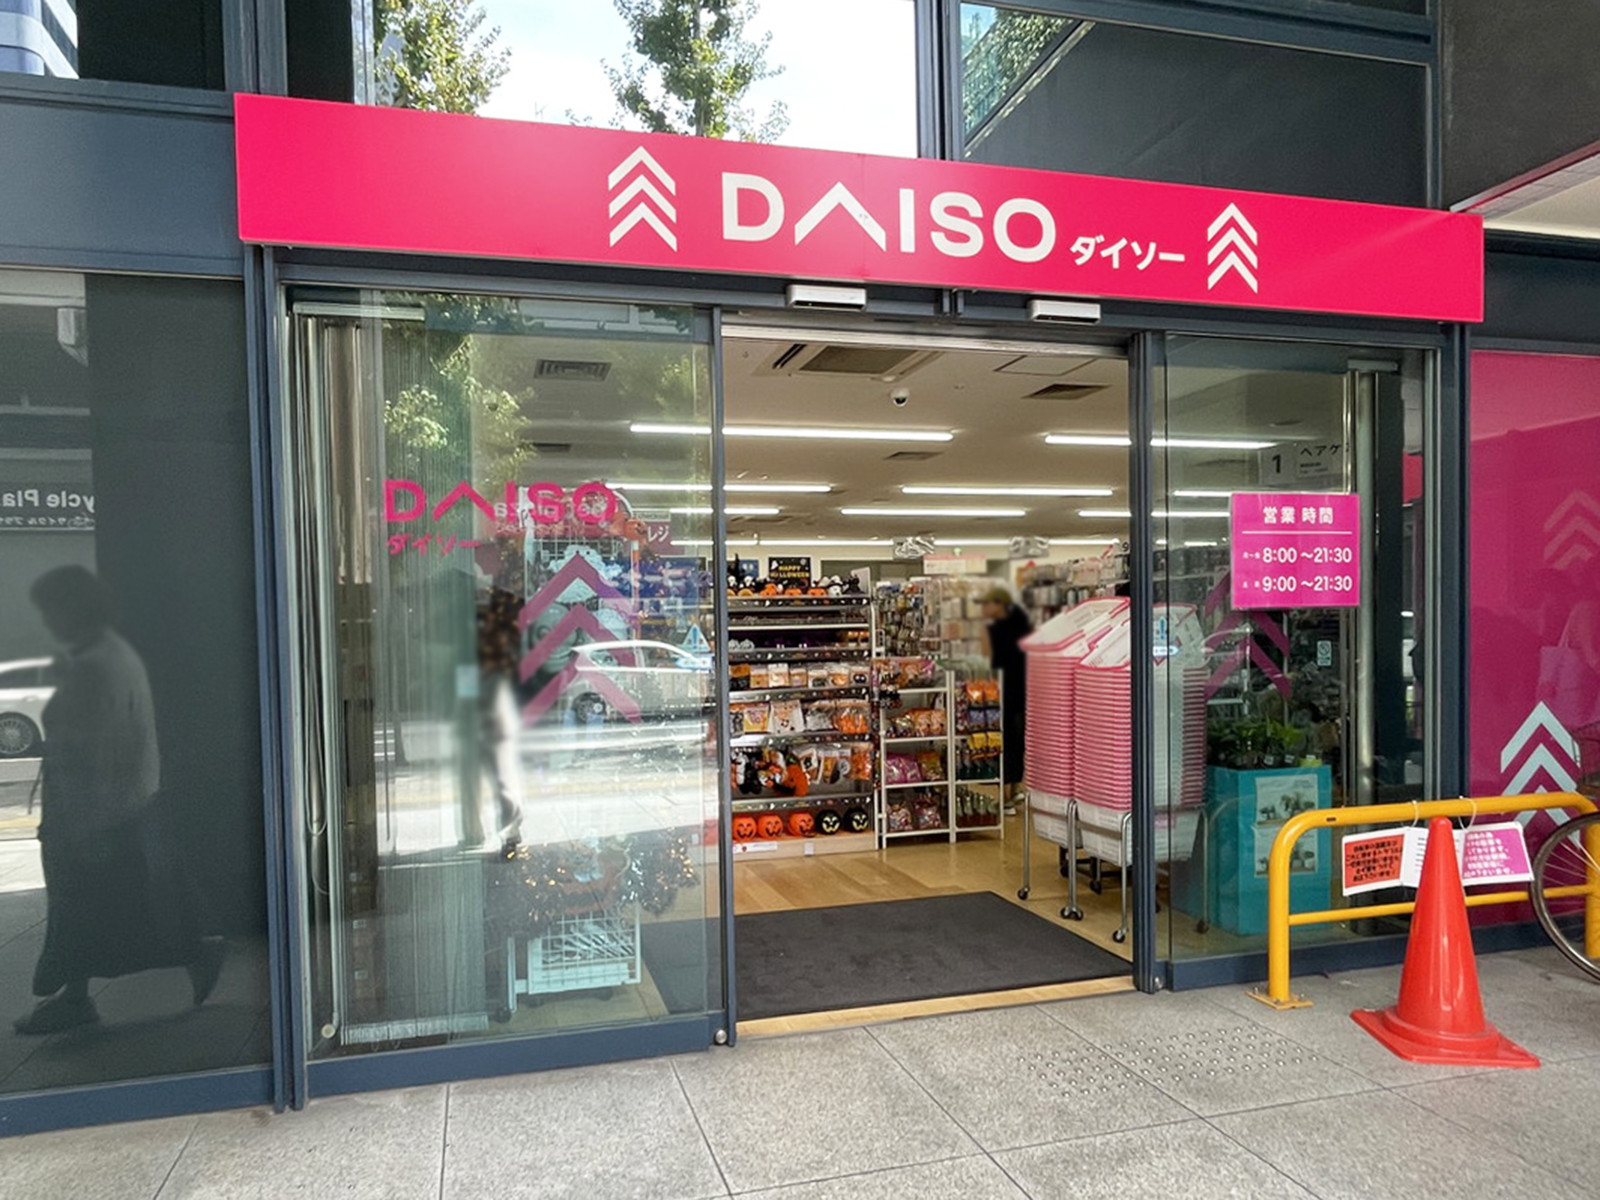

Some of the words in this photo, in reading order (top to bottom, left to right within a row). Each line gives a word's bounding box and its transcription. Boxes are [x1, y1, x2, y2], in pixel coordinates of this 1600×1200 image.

[722, 172, 1056, 263] DAISO
[1070, 234, 1185, 270] ダイソー
[1272, 454, 1281, 473] 1
[383, 479, 617, 523] DAISO
[385, 533, 480, 555] ダイソー
[1263, 547, 1297, 563] 8:00
[1262, 576, 1297, 592] 9:00
